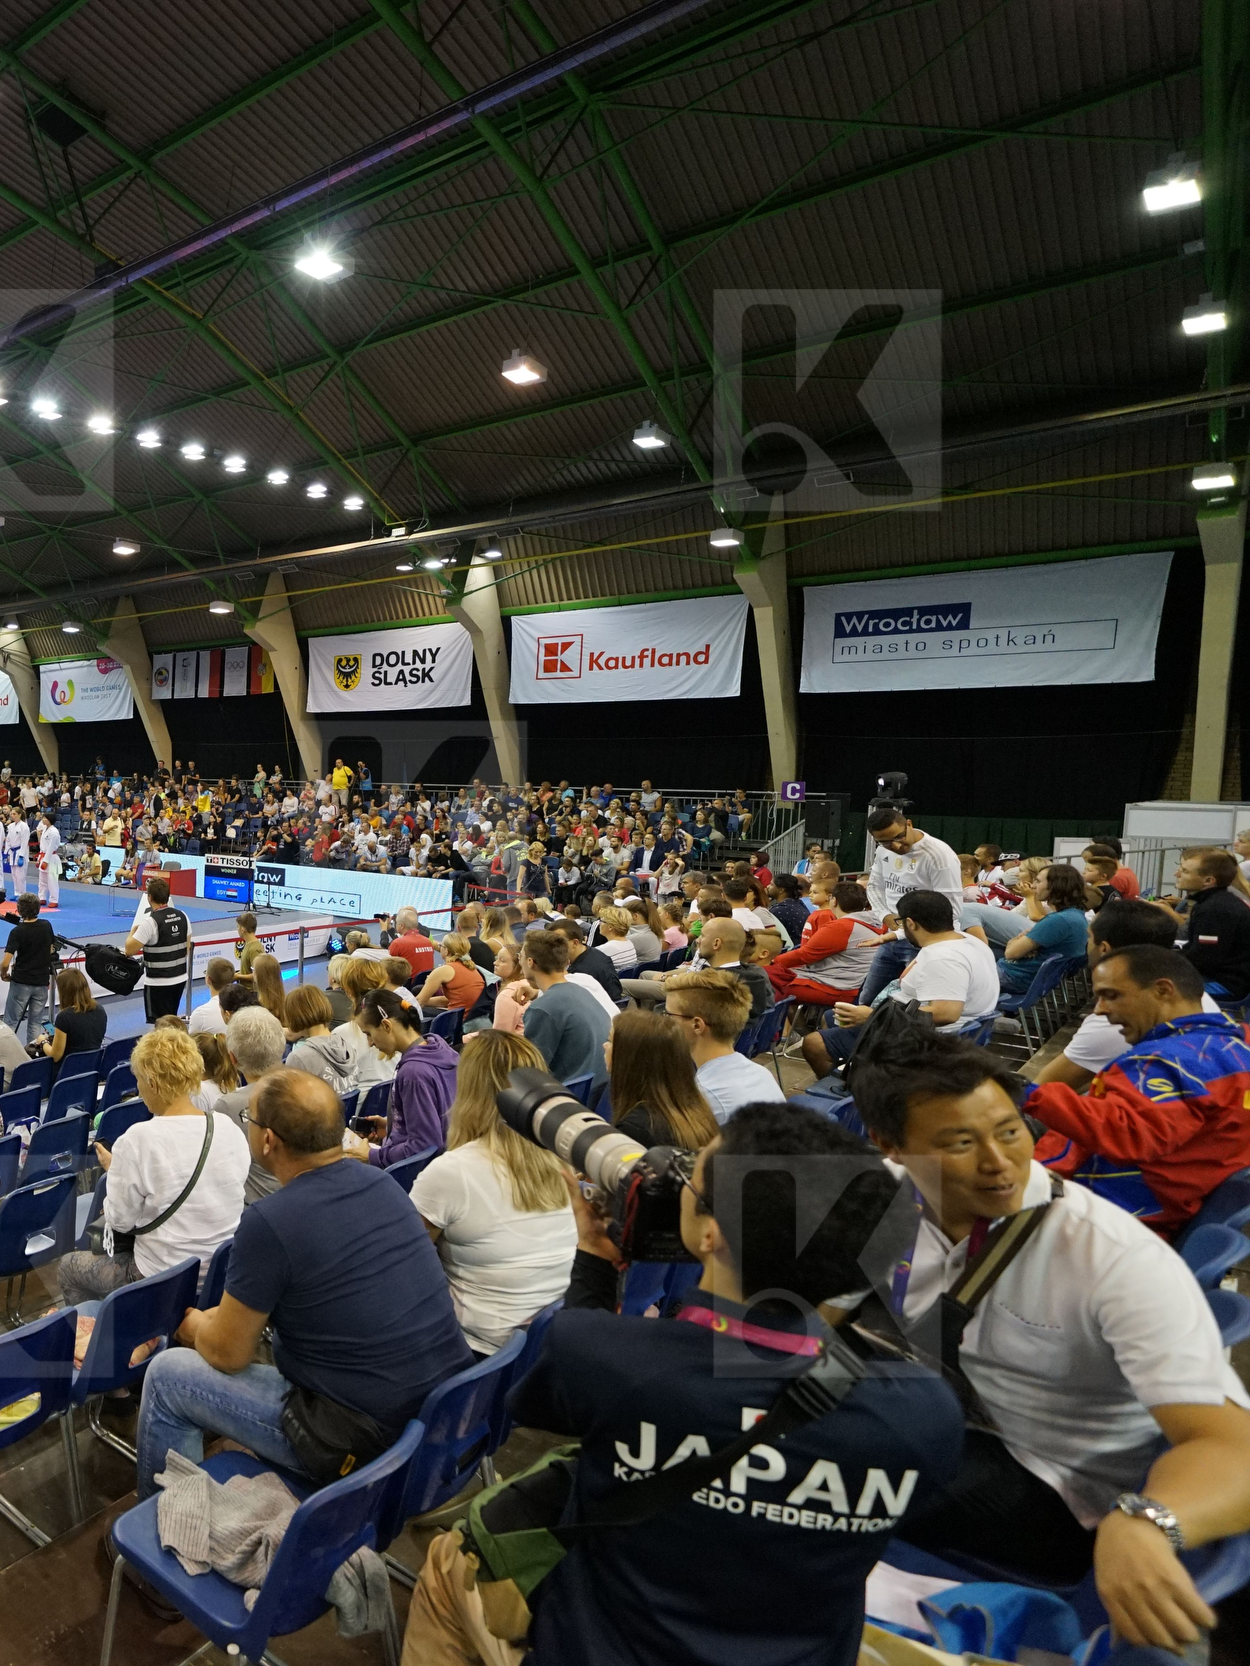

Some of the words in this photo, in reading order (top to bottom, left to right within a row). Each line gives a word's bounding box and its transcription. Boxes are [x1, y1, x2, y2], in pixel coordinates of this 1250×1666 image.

[840, 609, 963, 634] Wrocław
[840, 639, 927, 656] miasto
[941, 629, 1056, 653] spotkań
[371, 647, 441, 669] DOLNY
[588, 644, 711, 672] Kaufland
[370, 665, 435, 688] ŚLĄSK
[786, 783, 801, 799] C
[220, 857, 254, 867] TISSOT
[884, 880, 918, 893] mirates
[614, 1420, 919, 1517] JAPAN
[750, 1501, 898, 1533] FEDERATION
